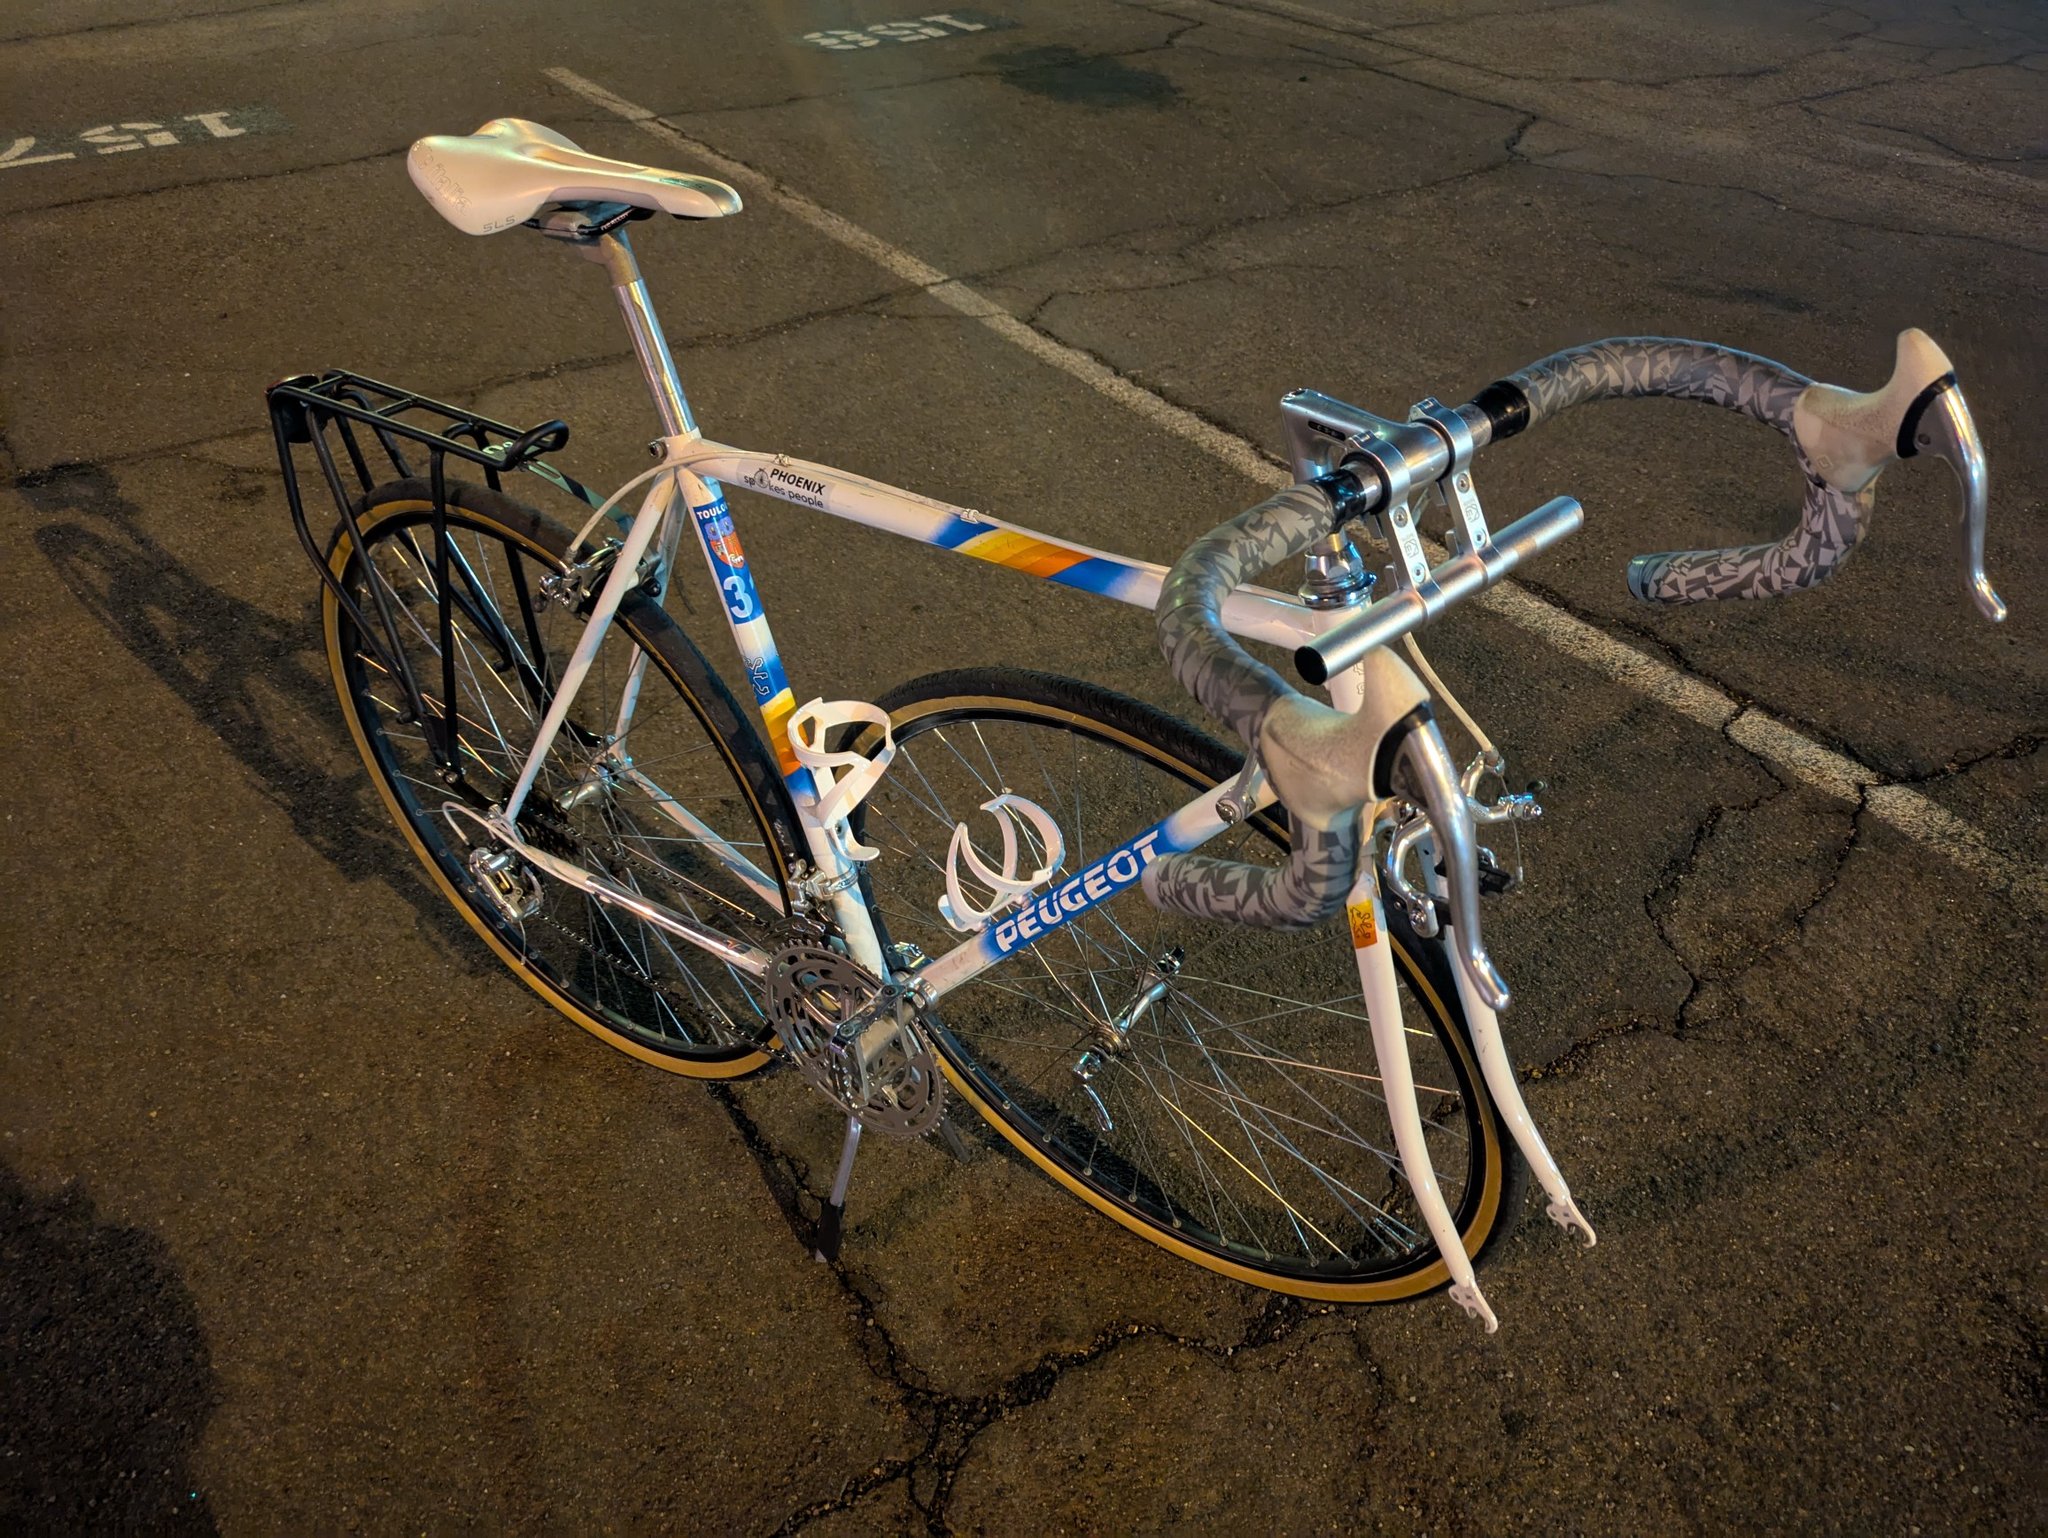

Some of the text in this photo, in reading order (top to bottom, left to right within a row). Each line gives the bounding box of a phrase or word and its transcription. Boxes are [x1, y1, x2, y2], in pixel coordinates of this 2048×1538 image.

[803, 14, 986, 50] 158
[0, 111, 246, 169] 157
[770, 468, 826, 496] PHOENIX
[788, 490, 824, 508] people
[995, 829, 1159, 953] PEUGEOT
